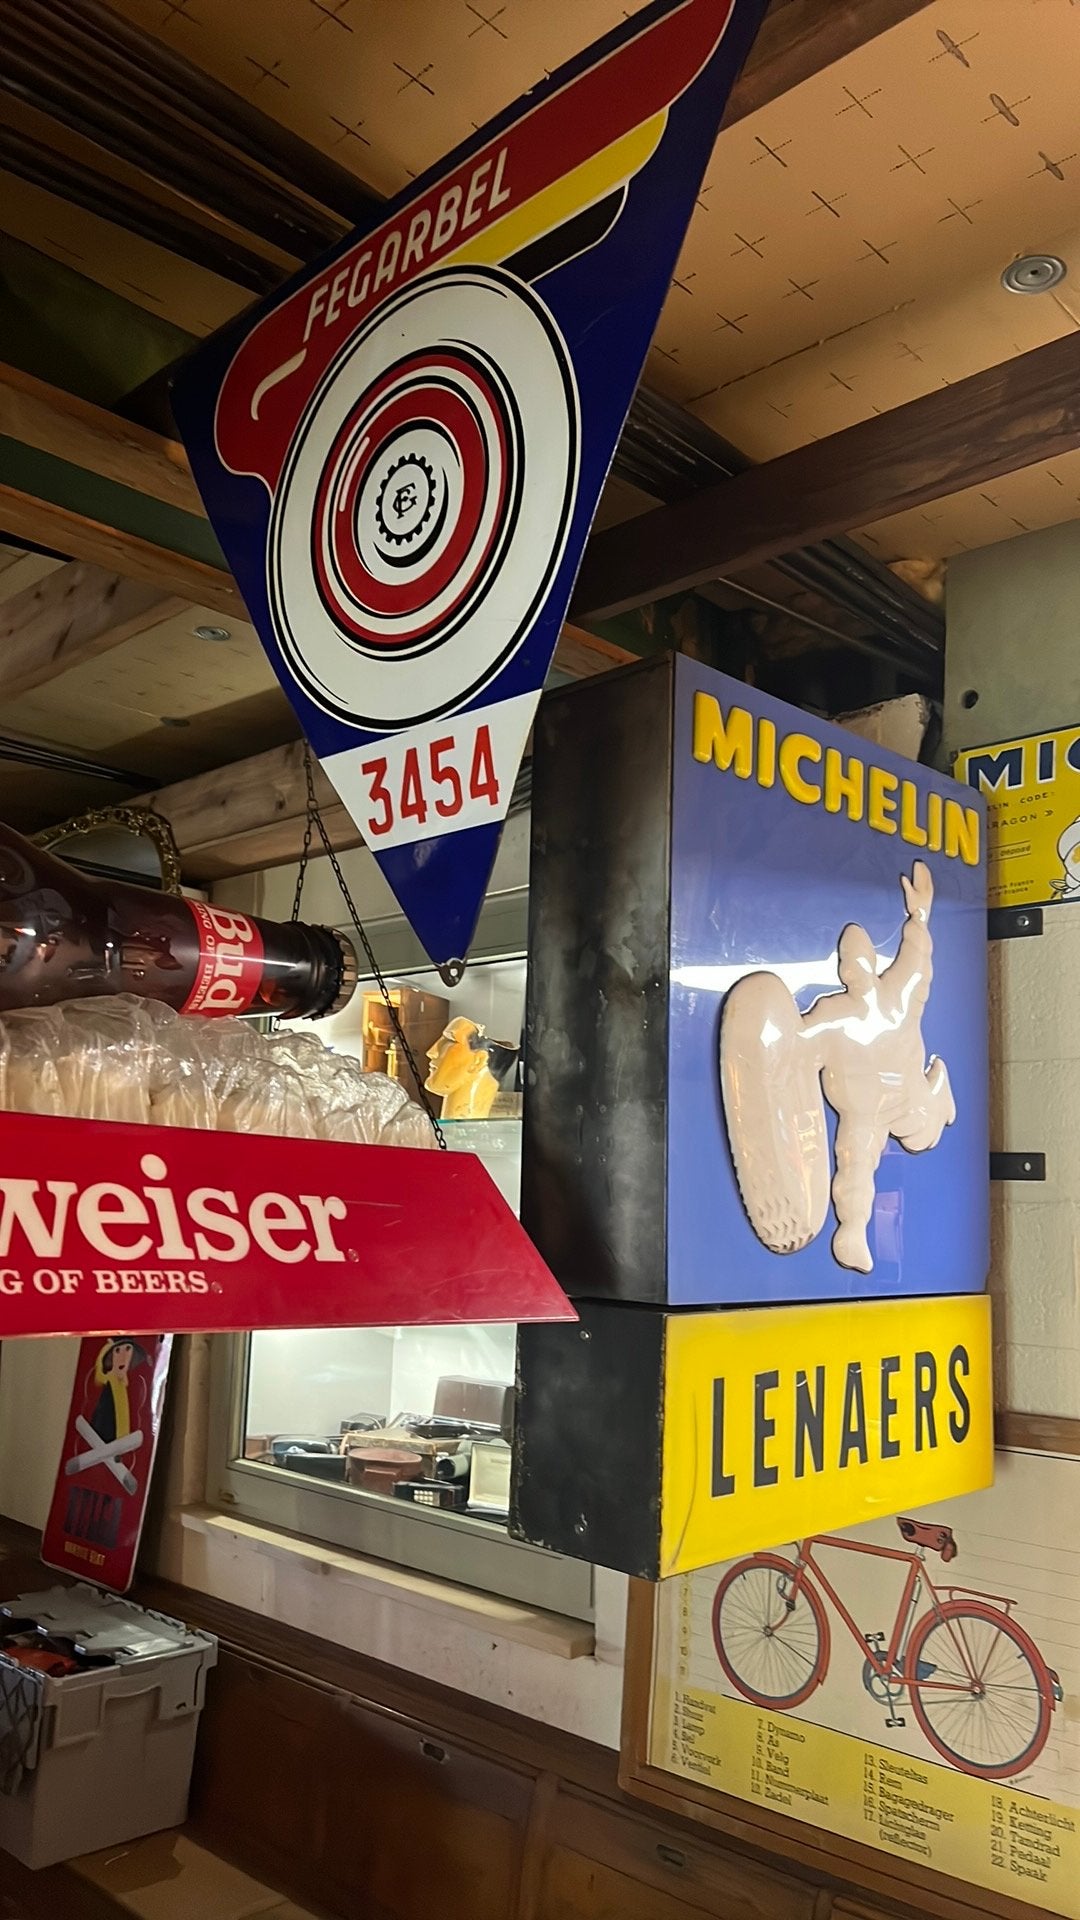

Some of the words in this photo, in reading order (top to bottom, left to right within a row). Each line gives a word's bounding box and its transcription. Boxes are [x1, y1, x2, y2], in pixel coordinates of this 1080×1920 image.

[303, 147, 512, 342] FEGARBEL
[361, 724, 499, 836] 3454
[692, 690, 980, 866] MICHELIN
[206, 935, 216, 954] OF
[200, 903, 254, 1011] Bud
[33, 1269, 84, 1294] OF
[93, 1269, 209, 1294] BEERS
[711, 1344, 971, 1498] LENAERS
[767, 1734, 779, 1747] As
[768, 1721, 805, 1743] Dynamo
[767, 1747, 789, 1766] Velg
[864, 1753, 876, 1767] 13.
[751, 1769, 763, 1782] 11.
[766, 1760, 789, 1777] Band
[864, 1767, 877, 1781] 14.
[864, 1780, 876, 1795] 15.
[879, 1786, 954, 1822] Bagagedrager
[864, 1794, 876, 1809] 16.
[864, 1808, 876, 1822] 17.
[991, 1809, 1006, 1825] 19.
[1009, 1801, 1076, 1832] Achterlicht
[991, 1824, 1006, 1840] 20.
[1009, 1830, 1061, 1857] Tandrad
[991, 1839, 1007, 1854] 21.
[1009, 1844, 1051, 1869] Pedaal
[991, 1853, 1006, 1868] 22.
[1010, 1860, 1047, 1882] Spaak
